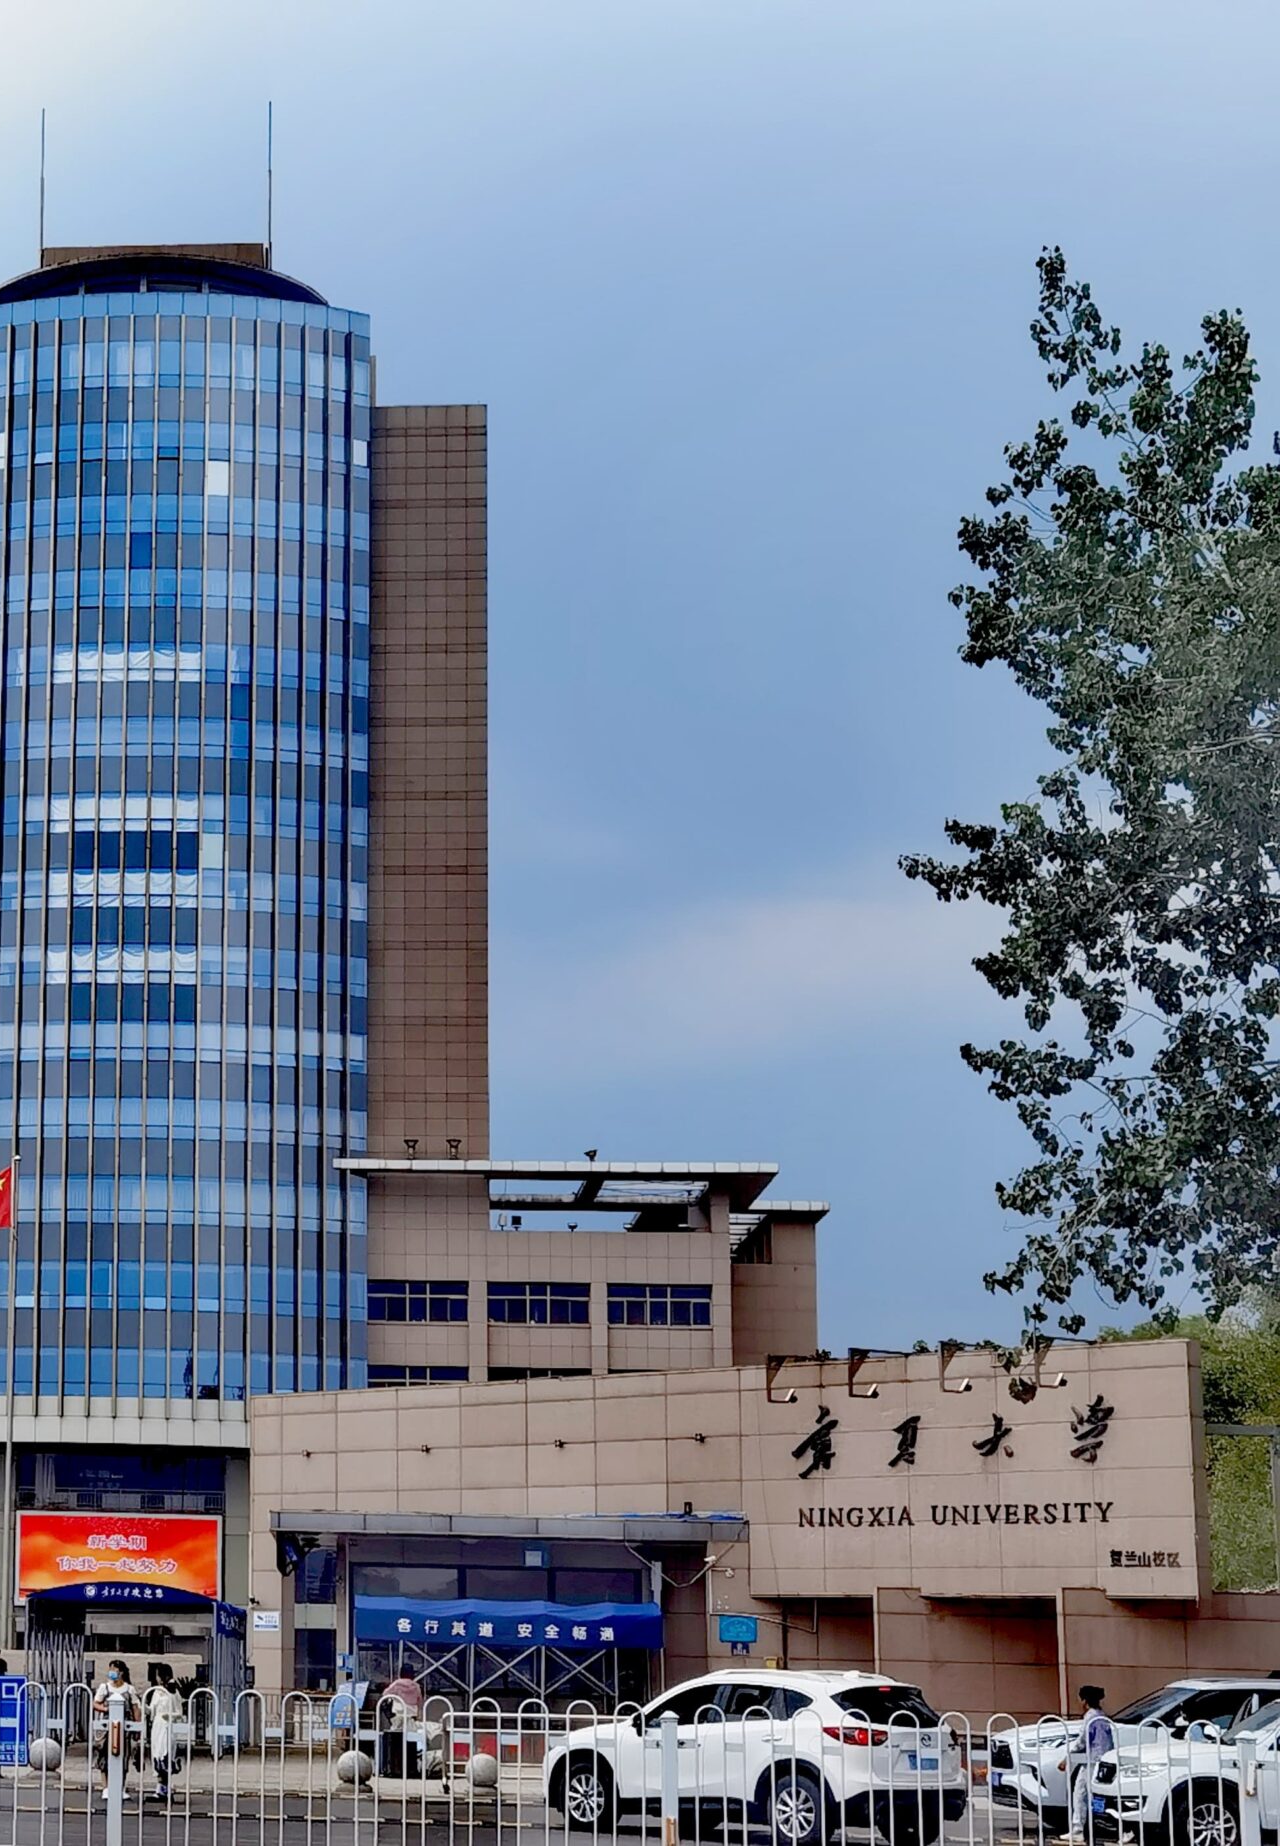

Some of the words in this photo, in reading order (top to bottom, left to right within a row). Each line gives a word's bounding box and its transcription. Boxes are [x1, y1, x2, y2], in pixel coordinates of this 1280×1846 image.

[792, 1394, 1115, 1479] 宁夏大学
[798, 1506, 915, 1528] NINGXIA
[931, 1502, 1114, 1526] UNIVERSITY
[87, 1534, 148, 1551] 新学期
[57, 1556, 178, 1575] 你我一起努力
[1109, 1549, 1182, 1568] 贺兰山校区
[397, 1618, 495, 1638] 各行其道
[517, 1623, 615, 1642] 安全畅通
